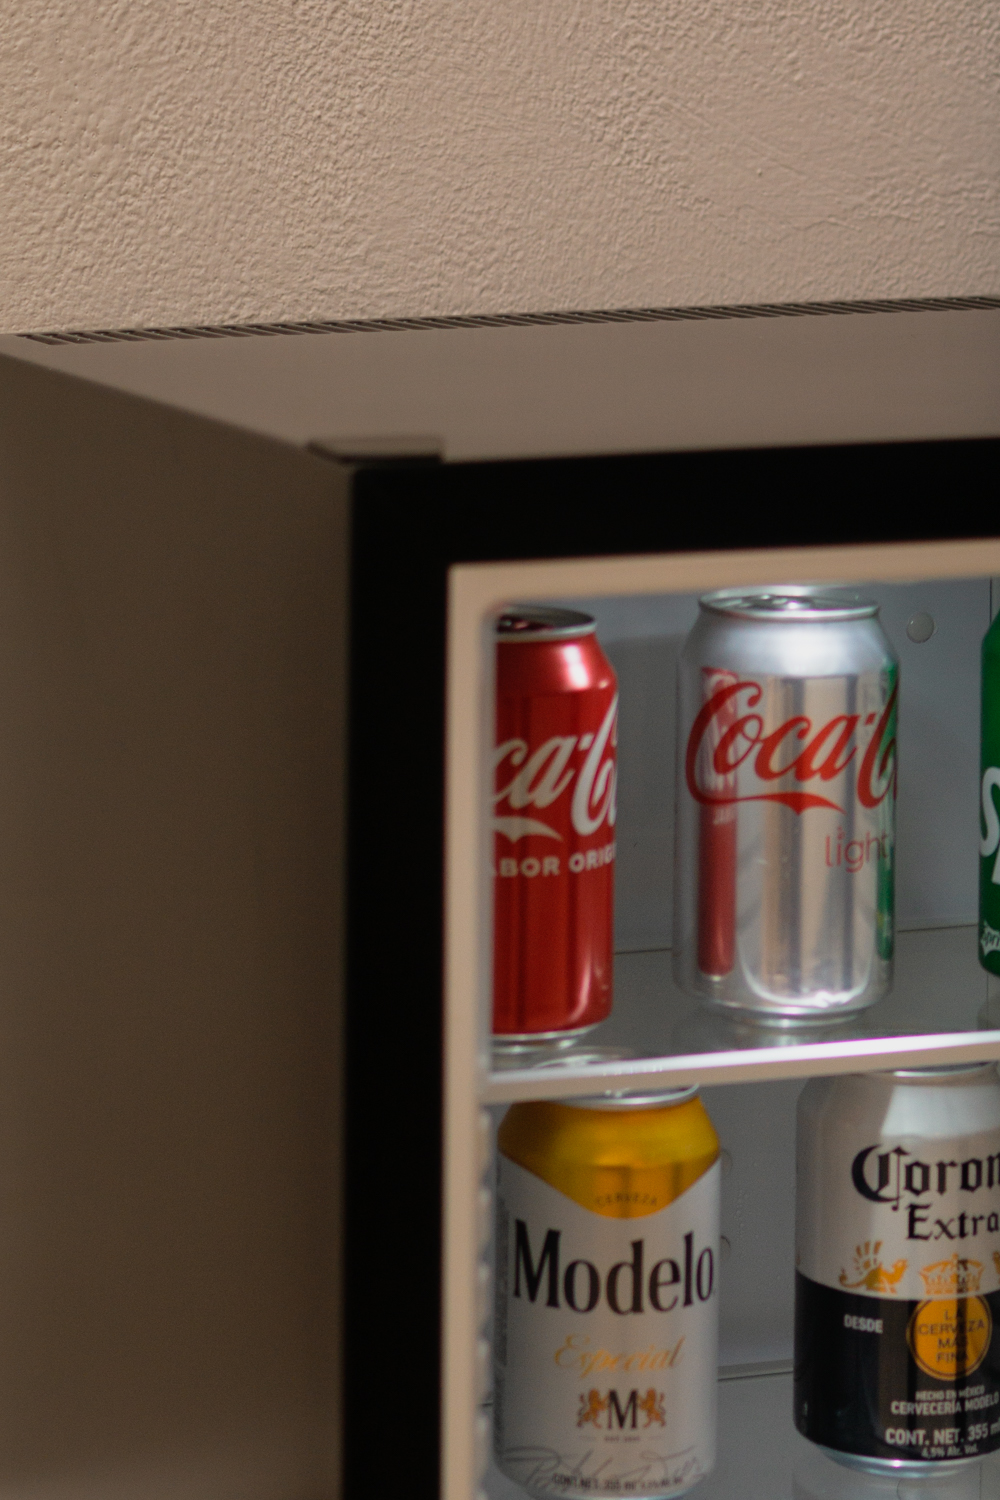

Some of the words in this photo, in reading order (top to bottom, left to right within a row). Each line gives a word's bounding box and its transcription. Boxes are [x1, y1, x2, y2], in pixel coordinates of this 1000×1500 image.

[825, 827, 889, 873] light
[499, 856, 560, 878] BOR
[906, 1203, 999, 1240] Extra
[513, 1218, 714, 1315] Modelo
[843, 1313, 884, 1334] DESDE
[917, 1318, 985, 1336] CERVEZA
[554, 1333, 686, 1379] Especial
[890, 1400, 962, 1416] CERVECERÍA
[964, 1391, 1000, 1412] MODELO
[914, 1389, 944, 1401] HECHO
[945, 1389, 957, 1400] EN
[884, 1427, 930, 1446] CONT.
[932, 1427, 964, 1446] NET.
[967, 1422, 988, 1442] 355
